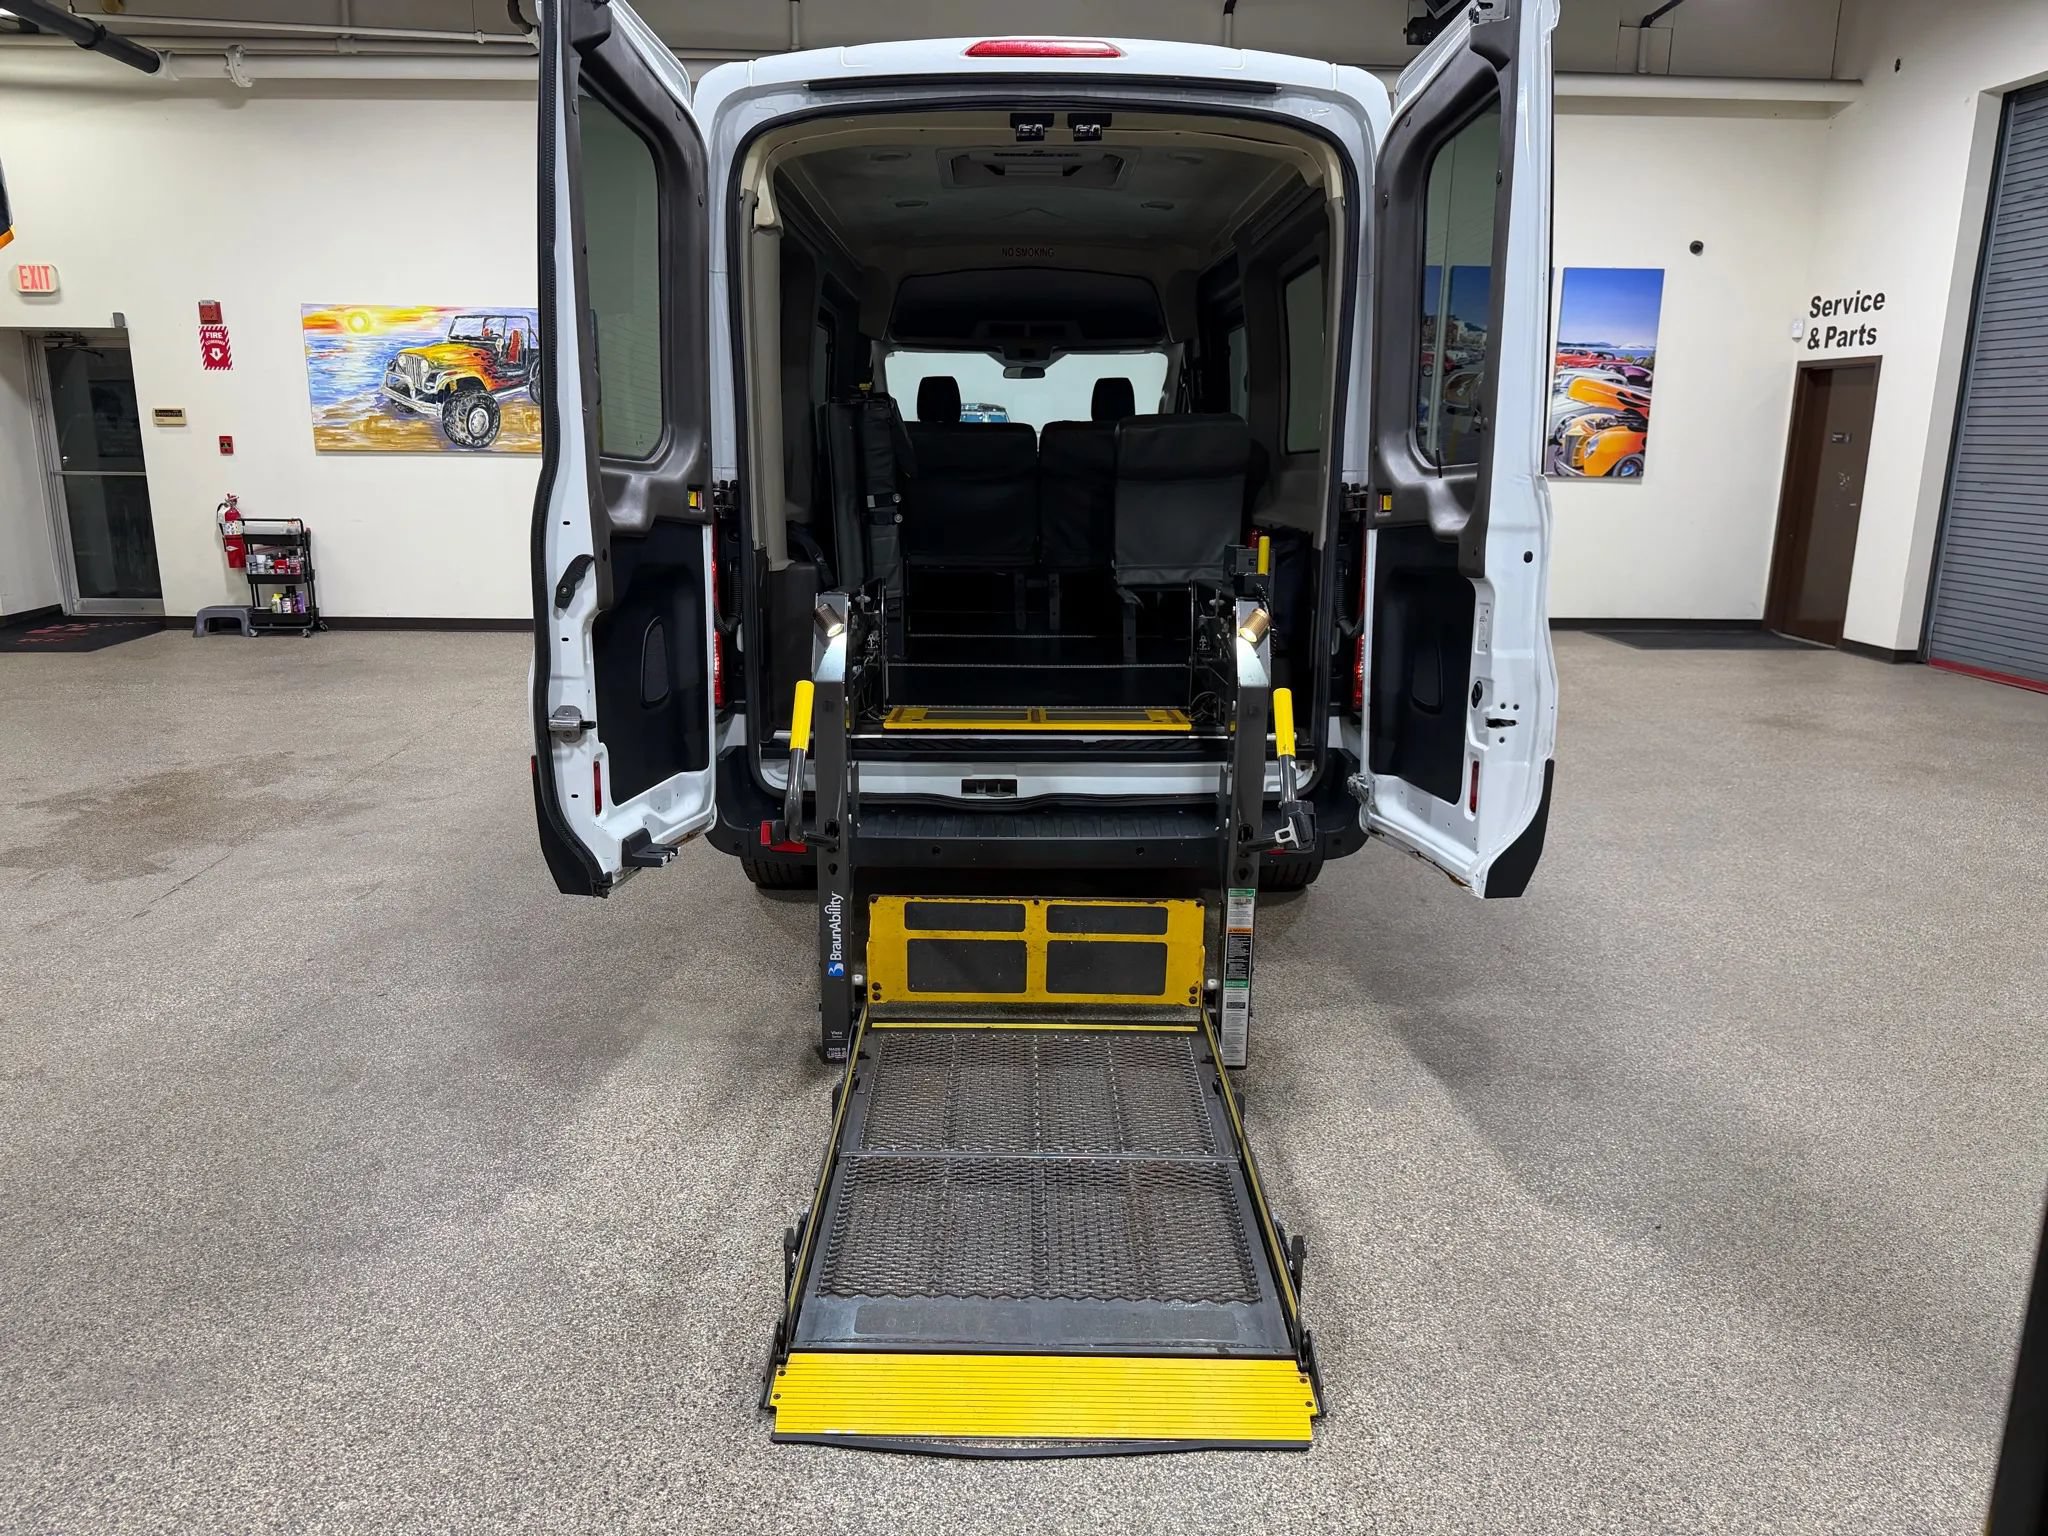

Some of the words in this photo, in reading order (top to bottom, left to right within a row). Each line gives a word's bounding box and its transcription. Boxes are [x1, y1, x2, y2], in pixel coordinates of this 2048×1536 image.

[1001, 247, 1014, 257] NO
[1015, 247, 1056, 257] SMOKING
[18, 265, 50, 289] EXIT
[1809, 290, 1886, 318] Service
[205, 331, 224, 339] FIRE
[1807, 327, 1820, 350] &
[1824, 323, 1877, 348] Parts
[824, 890, 844, 961] BraunAbility
